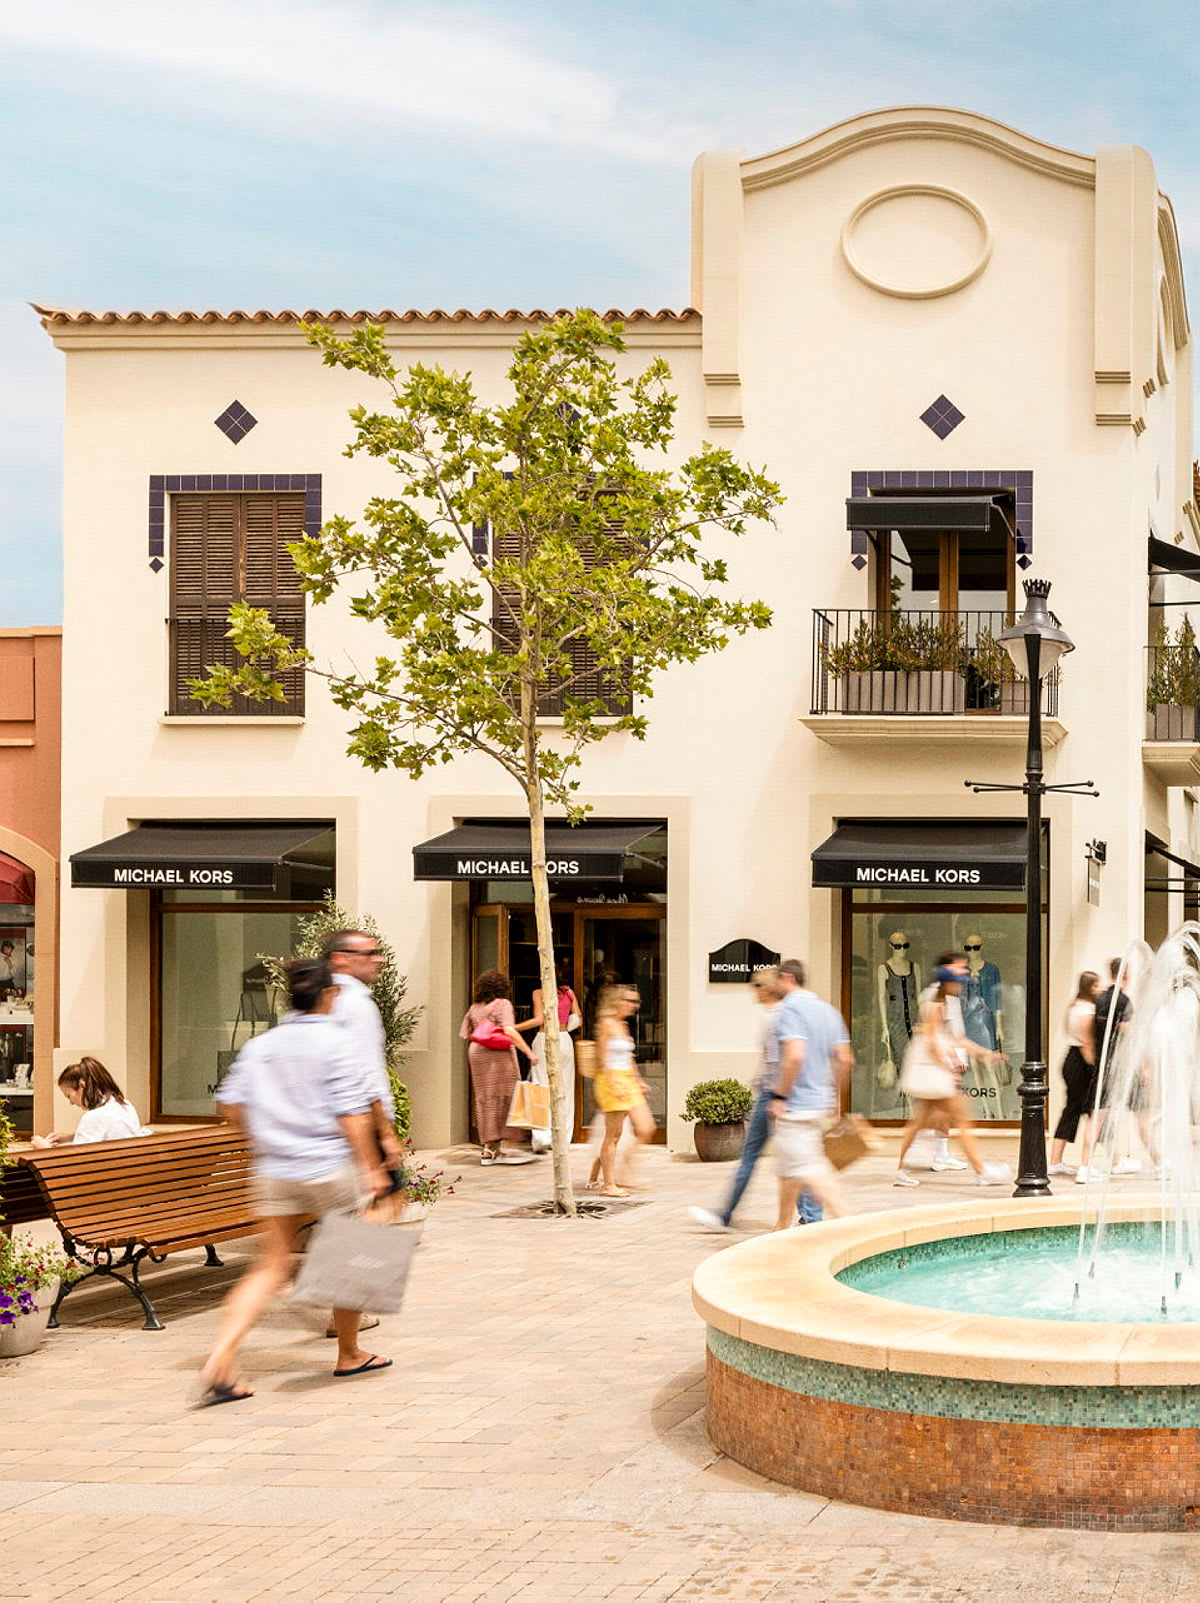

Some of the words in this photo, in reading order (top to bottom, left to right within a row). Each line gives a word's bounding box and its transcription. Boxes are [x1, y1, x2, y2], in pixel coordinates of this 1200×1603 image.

[457, 860, 530, 874] MICHAEL
[544, 860, 580, 875] ORS
[114, 868, 185, 883] MICHAEL
[189, 869, 234, 884] KORS
[856, 867, 930, 883] MICHAEL
[935, 869, 981, 884] KORS
[711, 963, 751, 972] MICHAEL
